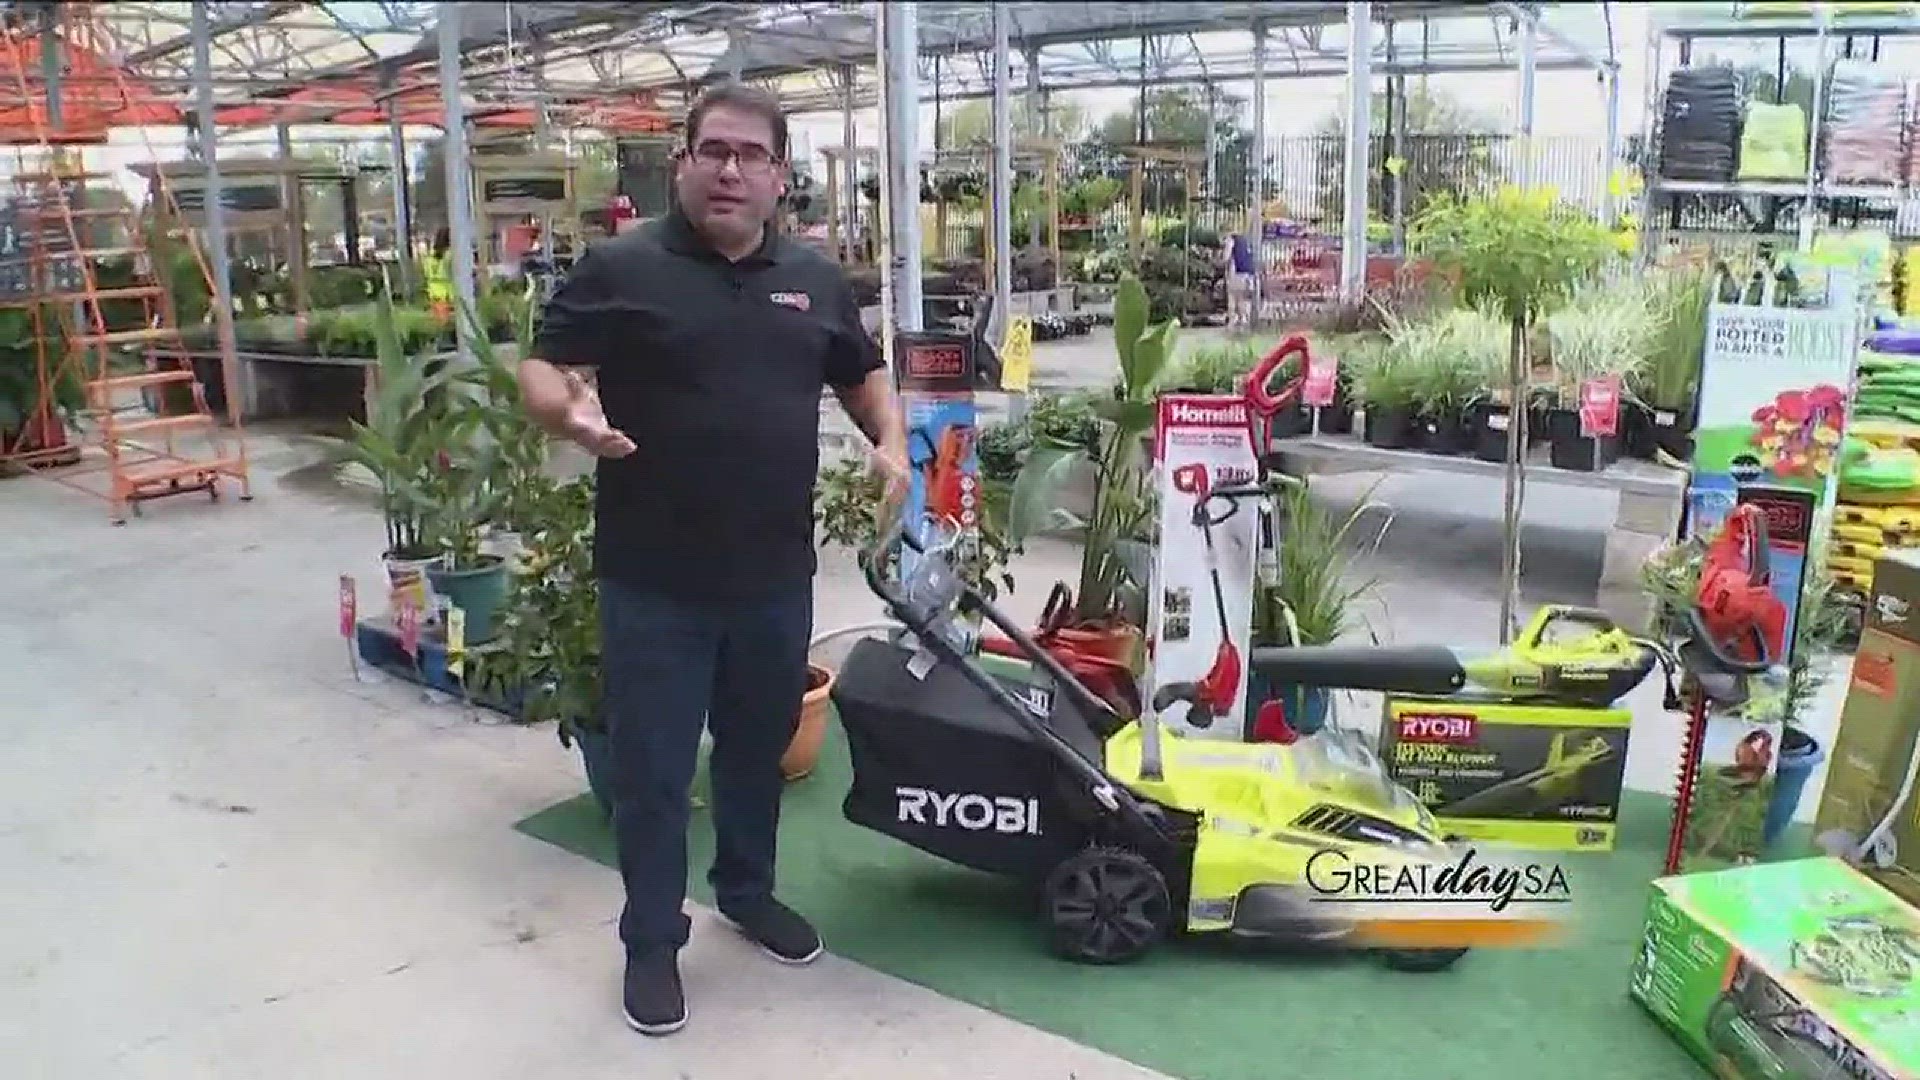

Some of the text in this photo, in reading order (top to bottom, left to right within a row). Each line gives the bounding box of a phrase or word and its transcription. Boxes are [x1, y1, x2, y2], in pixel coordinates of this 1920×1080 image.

[1716, 328, 1785, 344] POTTED
[1714, 341, 1768, 354] PLANTS
[1401, 716, 1472, 738] RYOBI
[896, 786, 1040, 835] RYOBI
